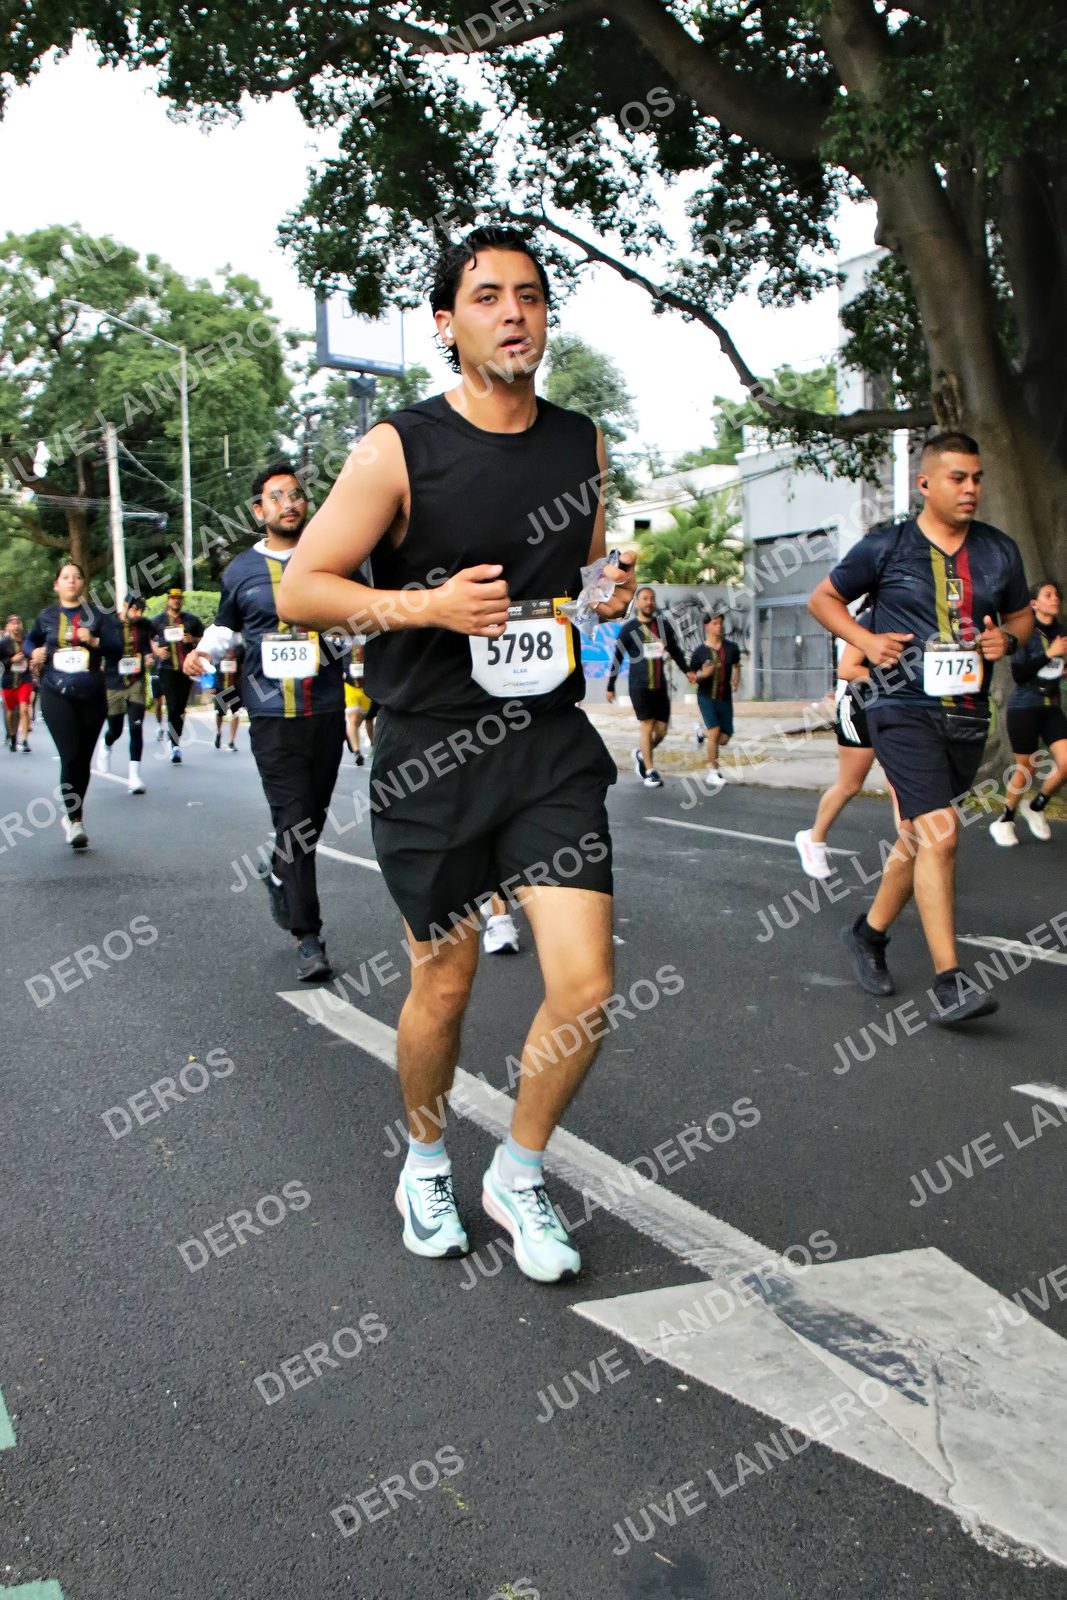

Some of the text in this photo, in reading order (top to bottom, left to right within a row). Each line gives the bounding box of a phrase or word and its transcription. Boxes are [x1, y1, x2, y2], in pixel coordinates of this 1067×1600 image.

[271, 647, 307, 661] 5638
[487, 630, 553, 666] 5798
[935, 659, 973, 676] 7175
